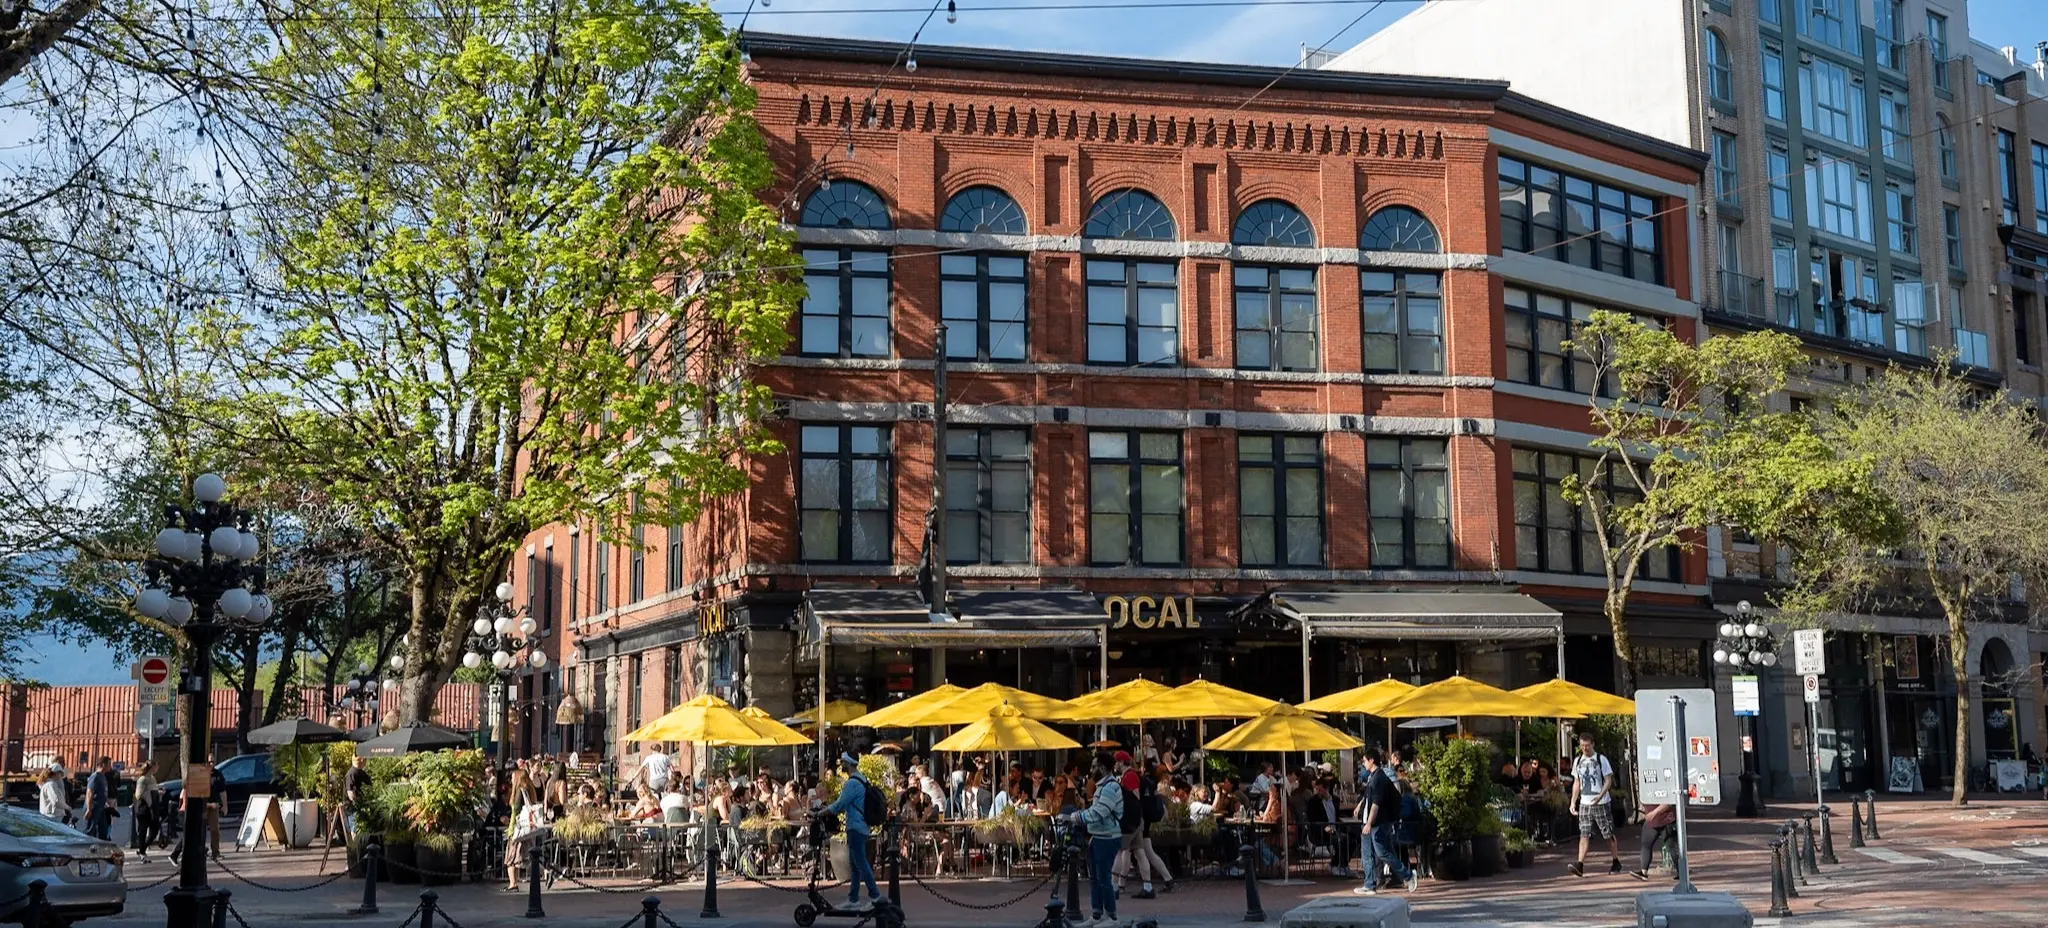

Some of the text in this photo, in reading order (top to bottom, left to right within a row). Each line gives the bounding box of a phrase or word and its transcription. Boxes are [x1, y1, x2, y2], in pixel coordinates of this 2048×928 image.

[1104, 596, 1200, 629] OCAL
[700, 602, 725, 636] LOCAL
[1800, 632, 1817, 641] BEGIN
[1803, 641, 1815, 649] ONE
[141, 693, 167, 701] BICYCLES
